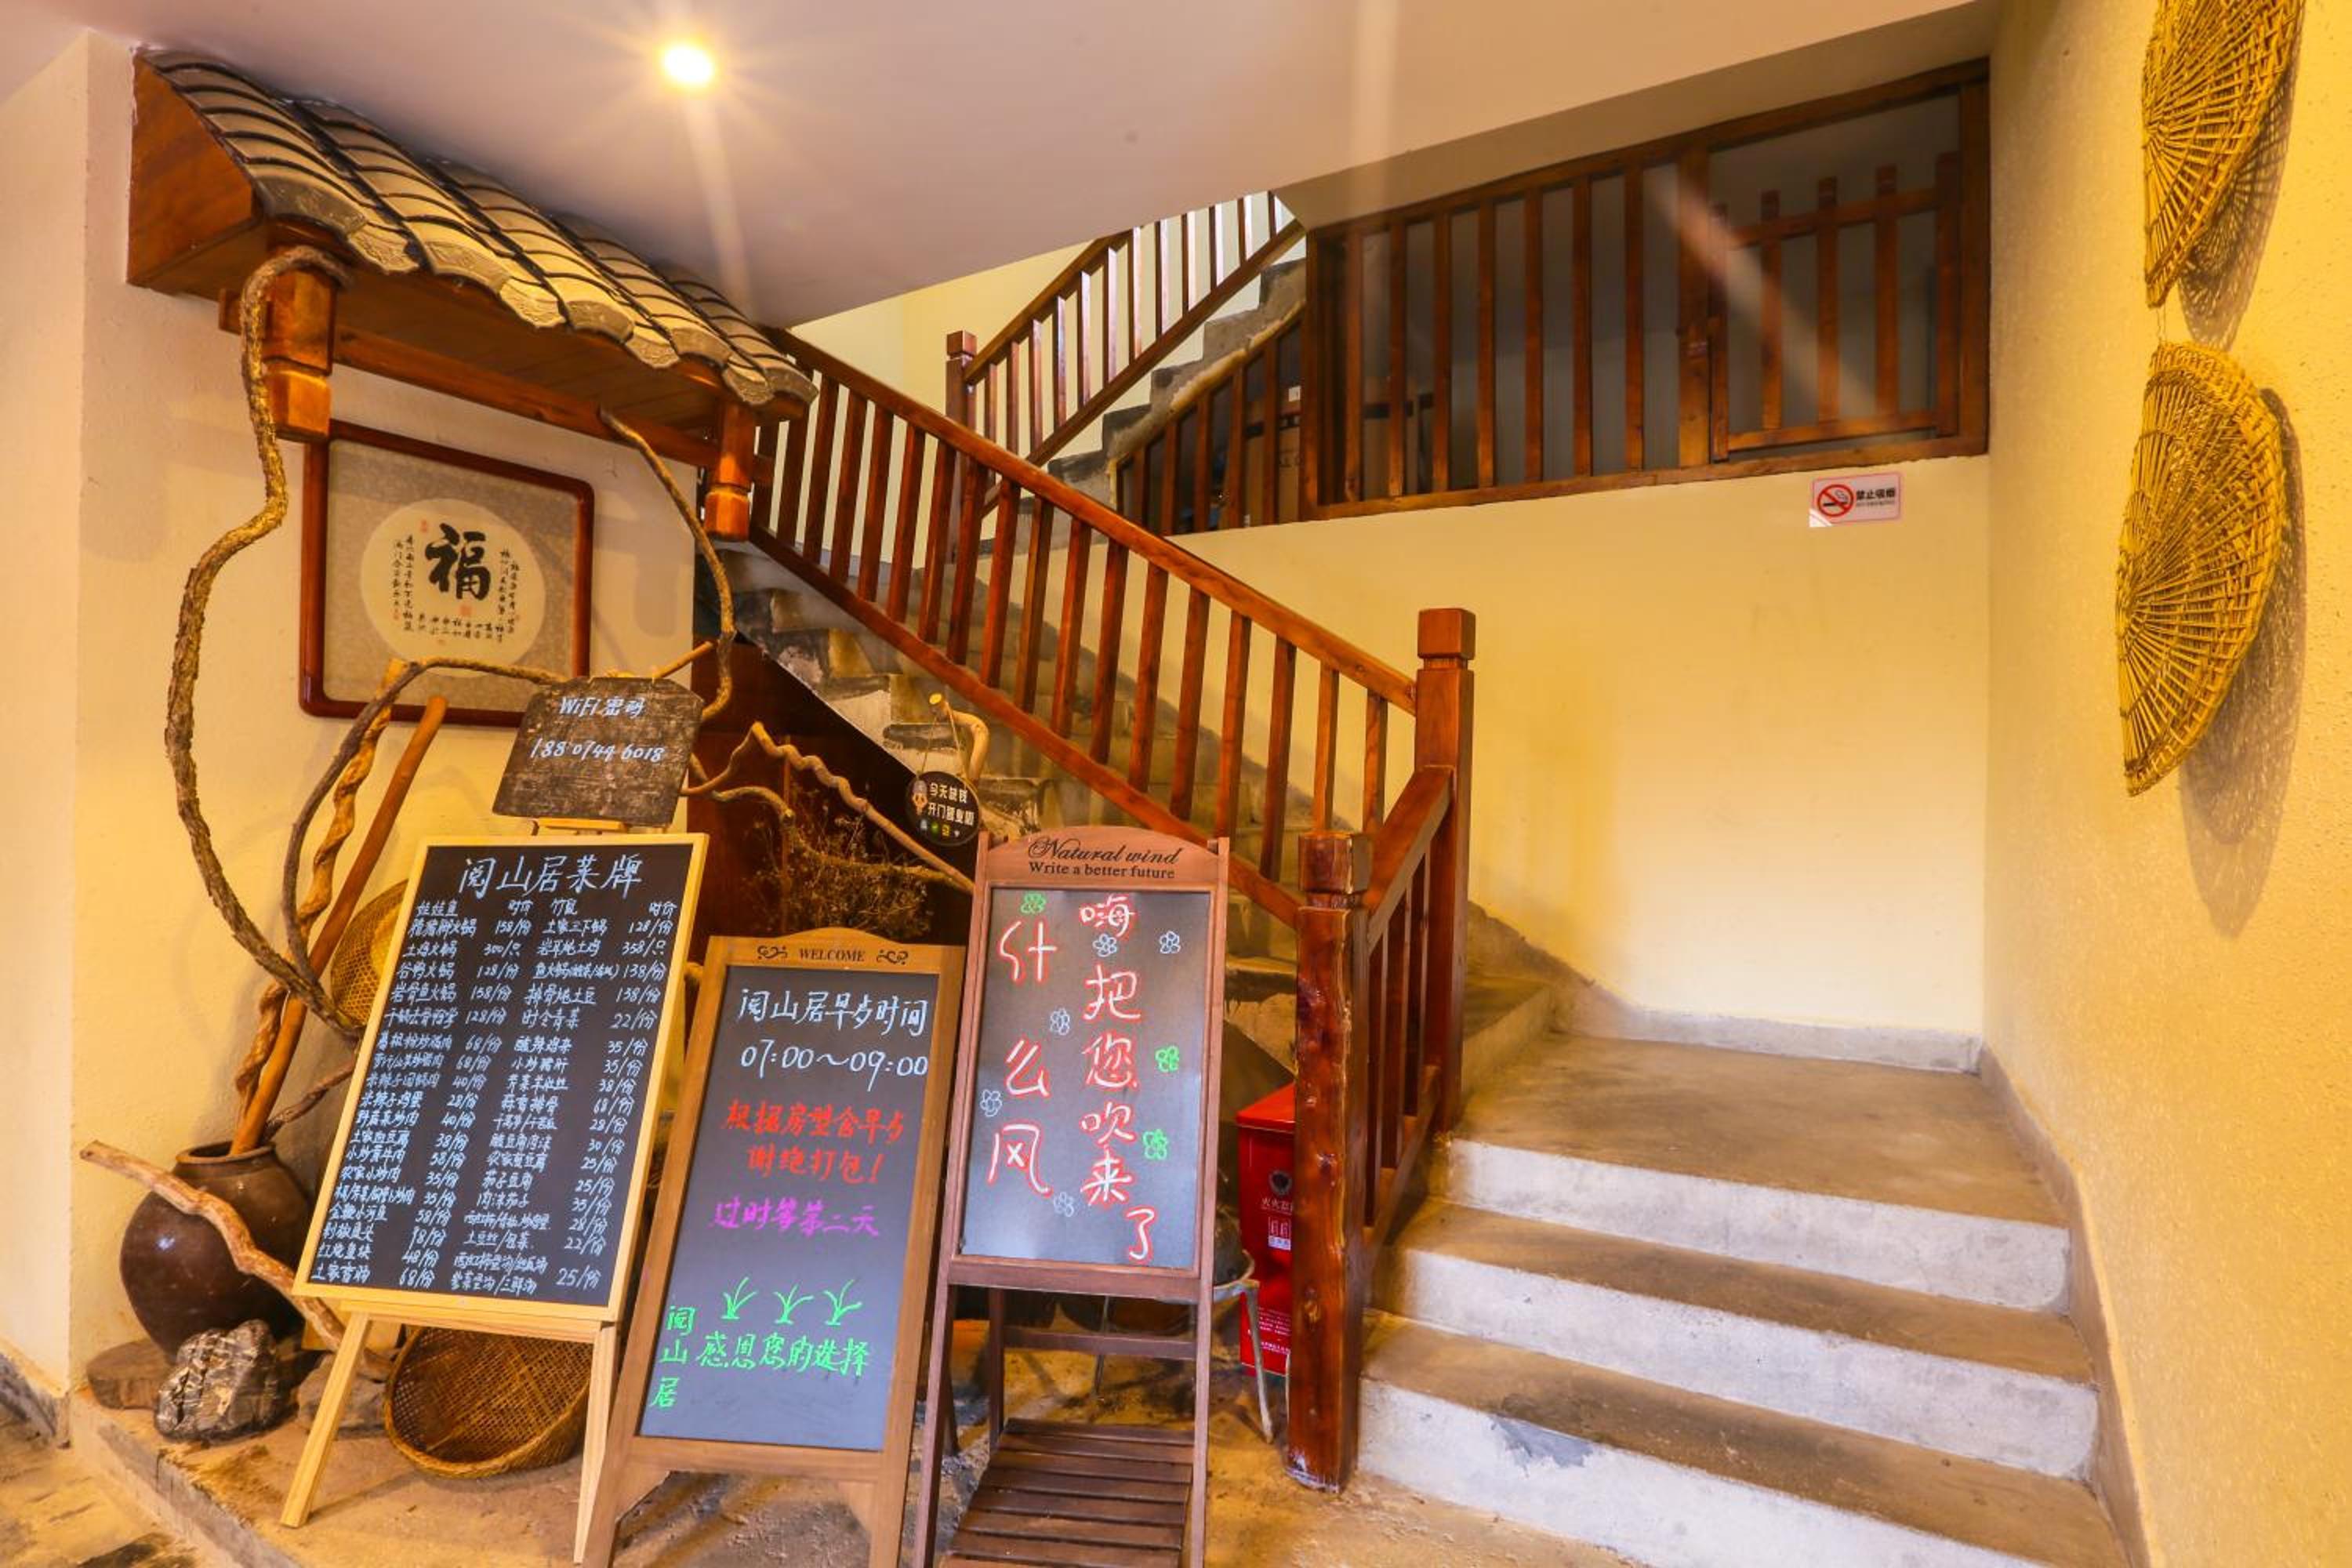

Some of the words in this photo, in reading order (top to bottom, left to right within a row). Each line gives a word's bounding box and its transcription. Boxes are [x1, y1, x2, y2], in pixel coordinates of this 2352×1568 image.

[425, 523, 491, 601] 福
[620, 742, 666, 763] 6018
[1028, 836, 1127, 862] Natural
[1126, 847, 1183, 865] wind
[1029, 862, 1069, 874] Write
[1072, 866, 1080, 875] a
[1084, 864, 1128, 877] better
[1131, 866, 1176, 879] future
[798, 948, 866, 963] WELCOME
[695, 1330, 869, 1377] 感恩您的选择
